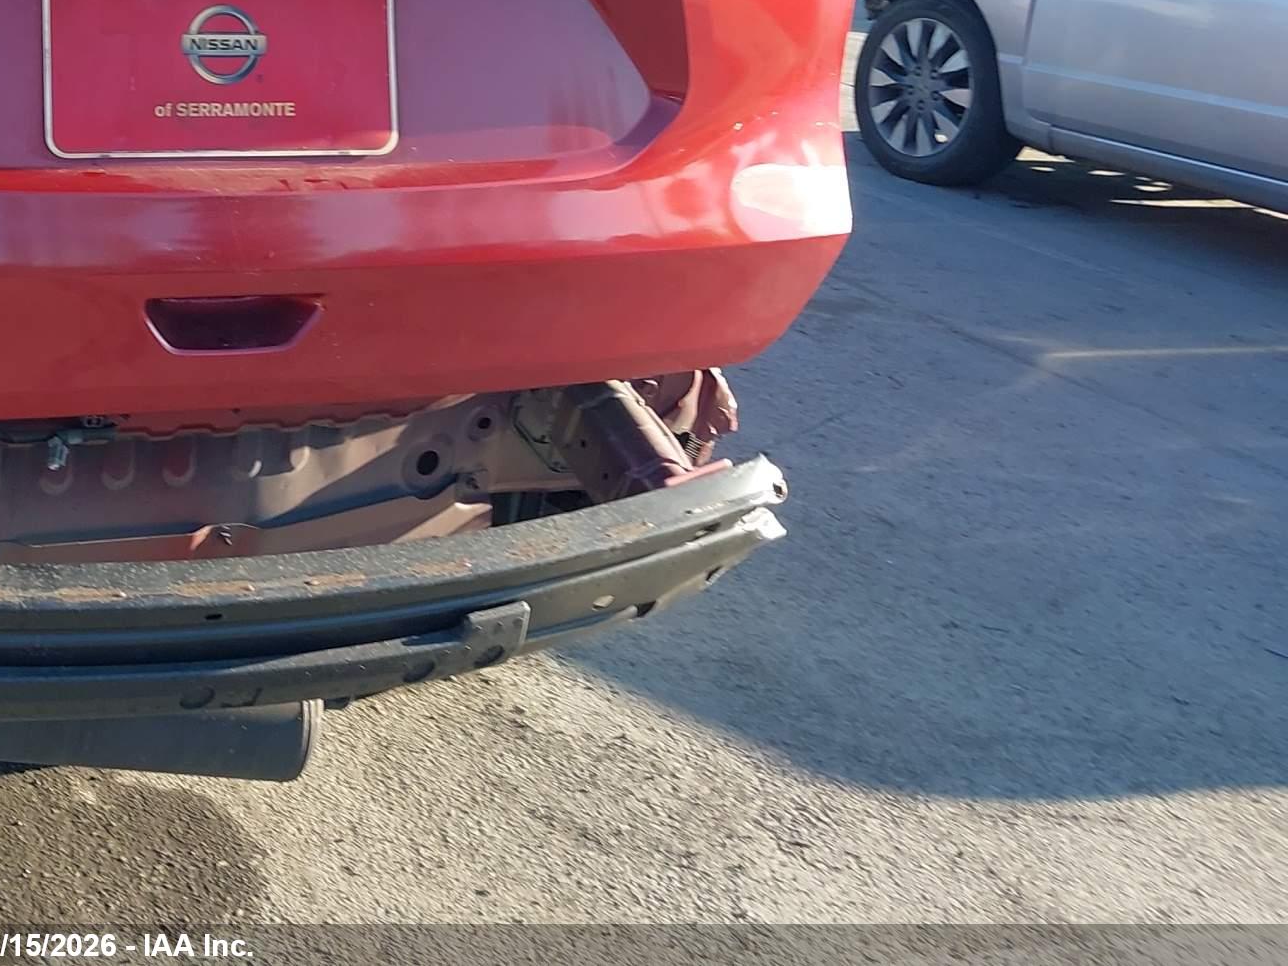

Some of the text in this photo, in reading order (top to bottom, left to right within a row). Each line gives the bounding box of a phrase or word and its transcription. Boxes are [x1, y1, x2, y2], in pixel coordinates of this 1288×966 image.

[190, 38, 259, 51] NISSAN
[154, 102, 296, 117] of SERRAMONTE
